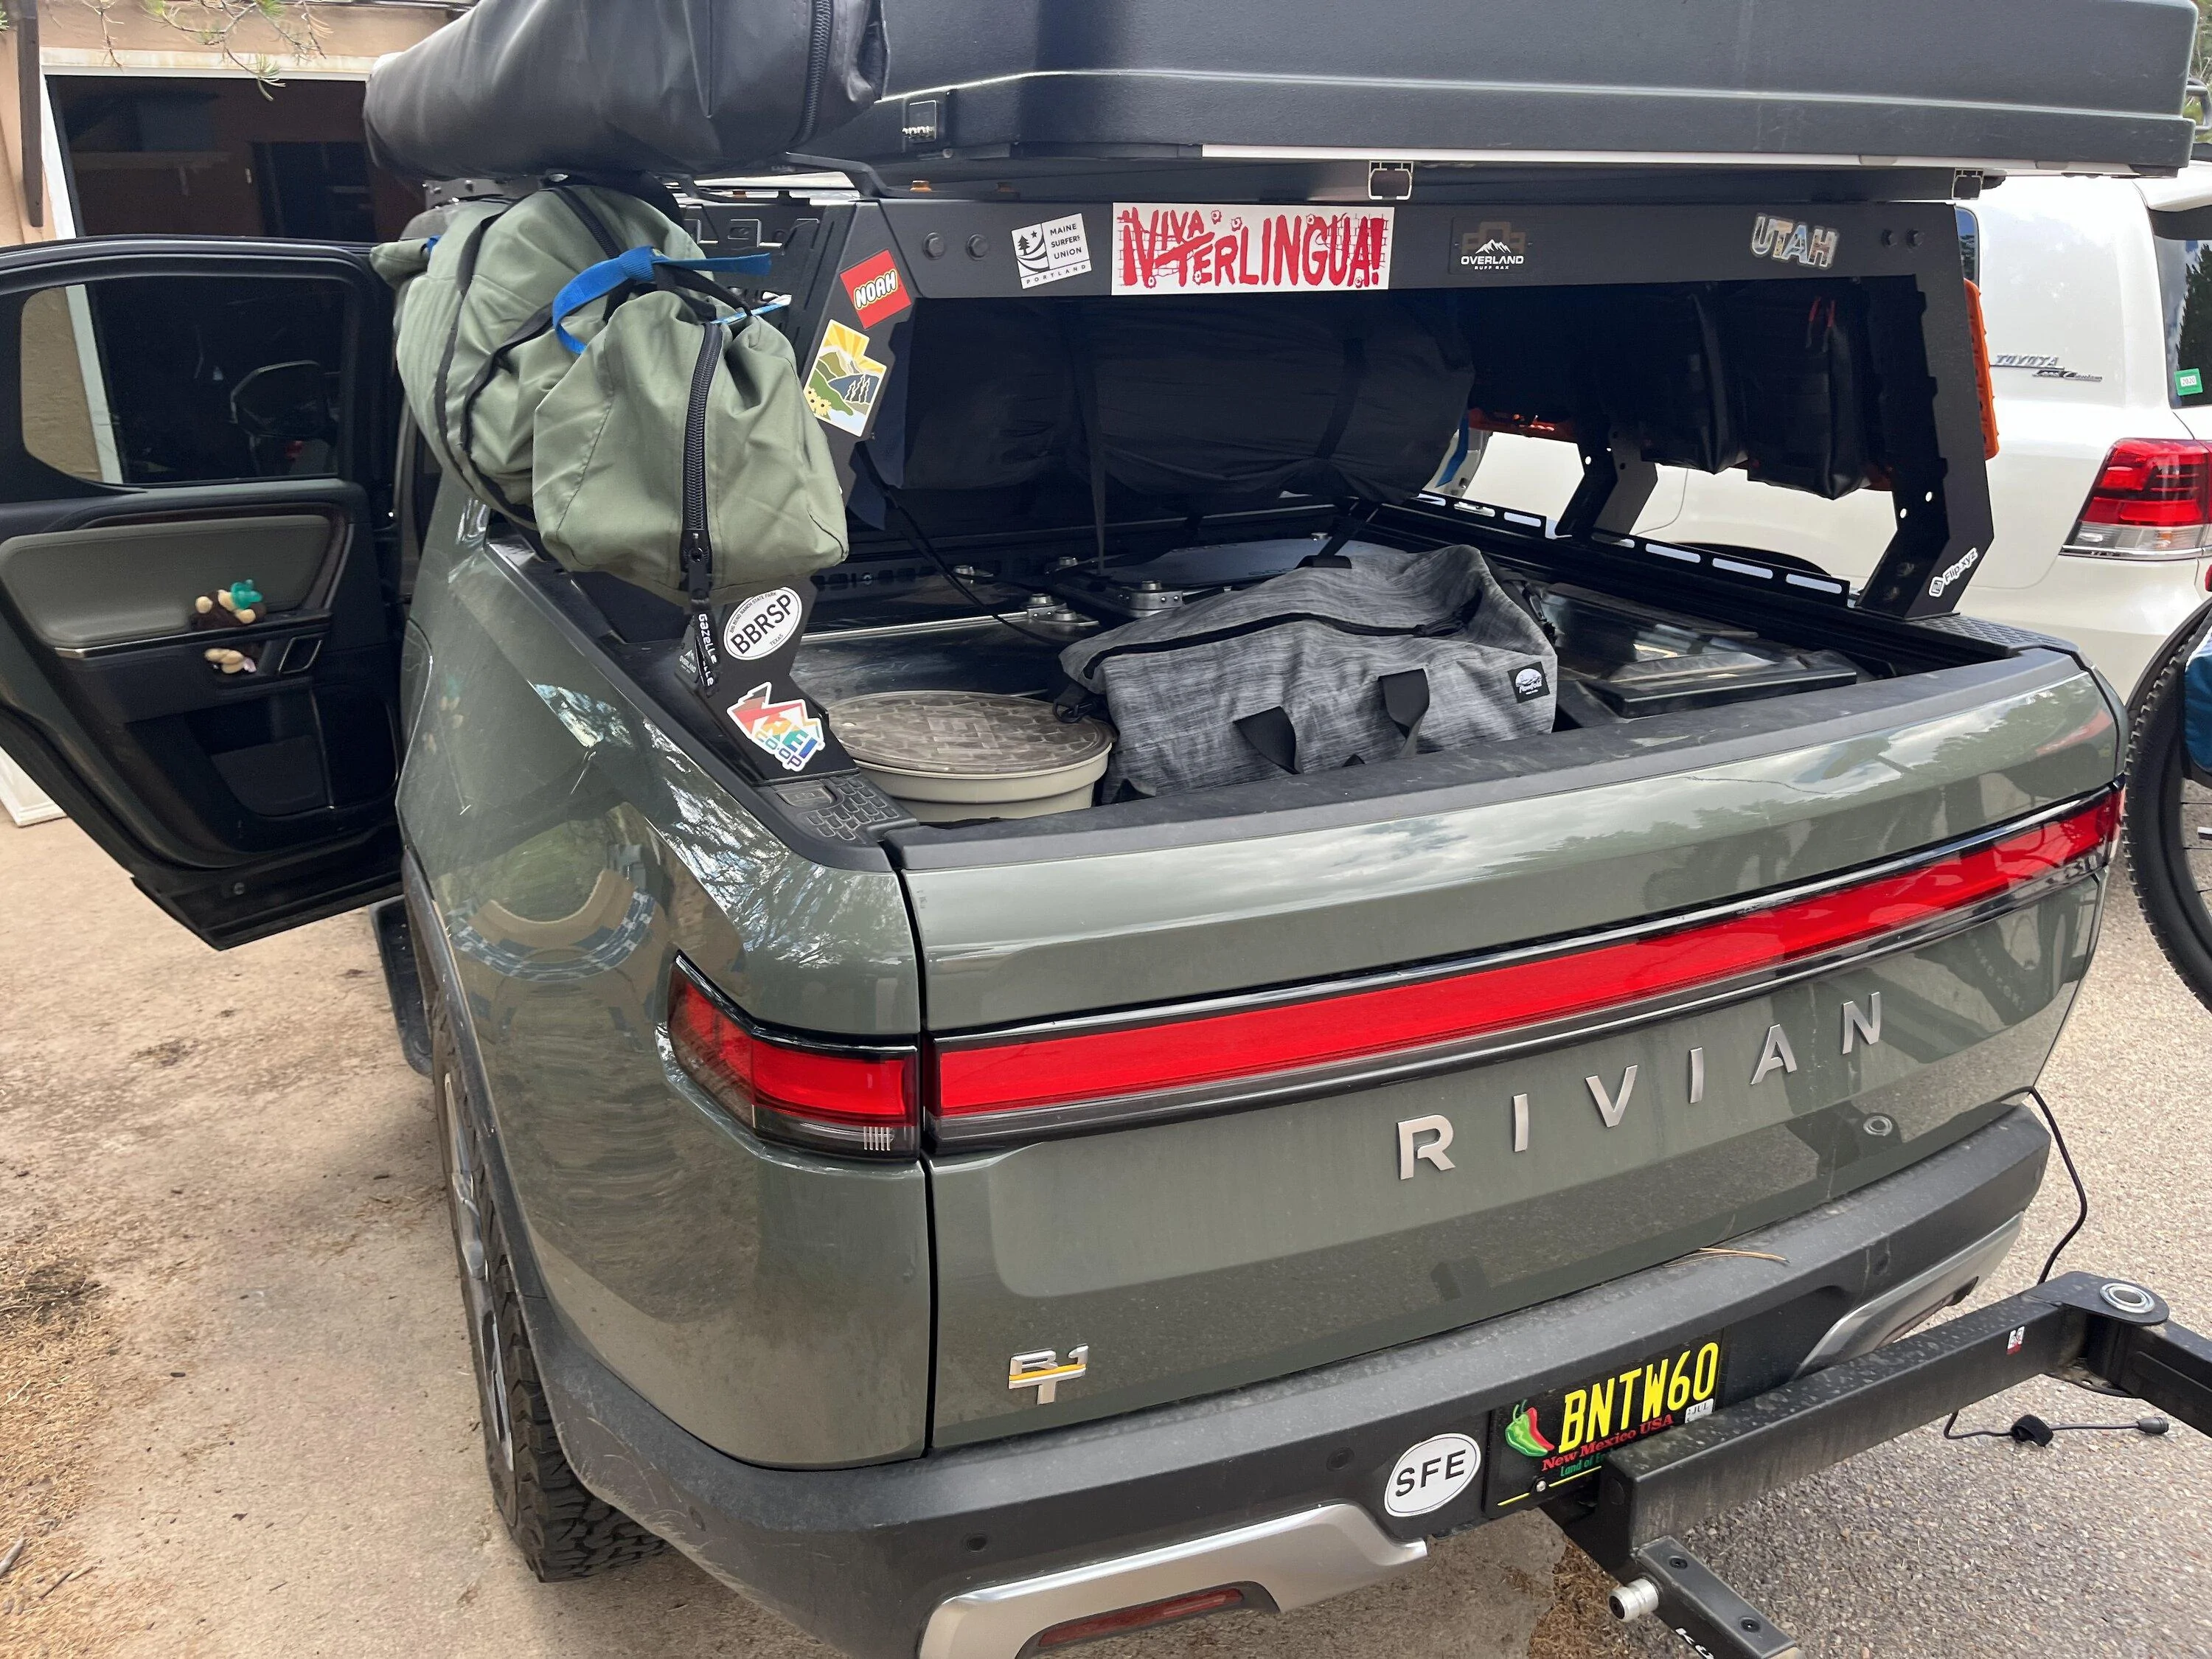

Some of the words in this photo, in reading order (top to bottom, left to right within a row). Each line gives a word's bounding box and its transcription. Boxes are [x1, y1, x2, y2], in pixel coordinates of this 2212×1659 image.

[1050, 223, 1077, 236] MAINE
[1751, 215, 1836, 268] UTAH
[1054, 247, 1082, 260] UNION
[1461, 255, 1524, 265] OVERLAND
[1026, 265, 1086, 285] PORTLAND
[854, 268, 899, 310] NOAH
[1995, 354, 2059, 366] TOYOTA
[740, 602, 753, 614] RANCH
[752, 596, 765, 605] STATE
[730, 594, 791, 654] BBRSP
[769, 634, 784, 646] TEXAS
[1397, 992, 1880, 1180] RIVIAN
[1559, 1342, 1719, 1454] BNTW60
[1692, 1402, 1709, 1414] JUL
[1541, 1452, 1579, 1471] New
[1580, 1430, 1636, 1457] Mexico
[1640, 1414, 1674, 1436] USA
[1395, 1450, 1466, 1497] SFE
[1560, 1462, 1583, 1477] Land
[1584, 1455, 1594, 1468] of
